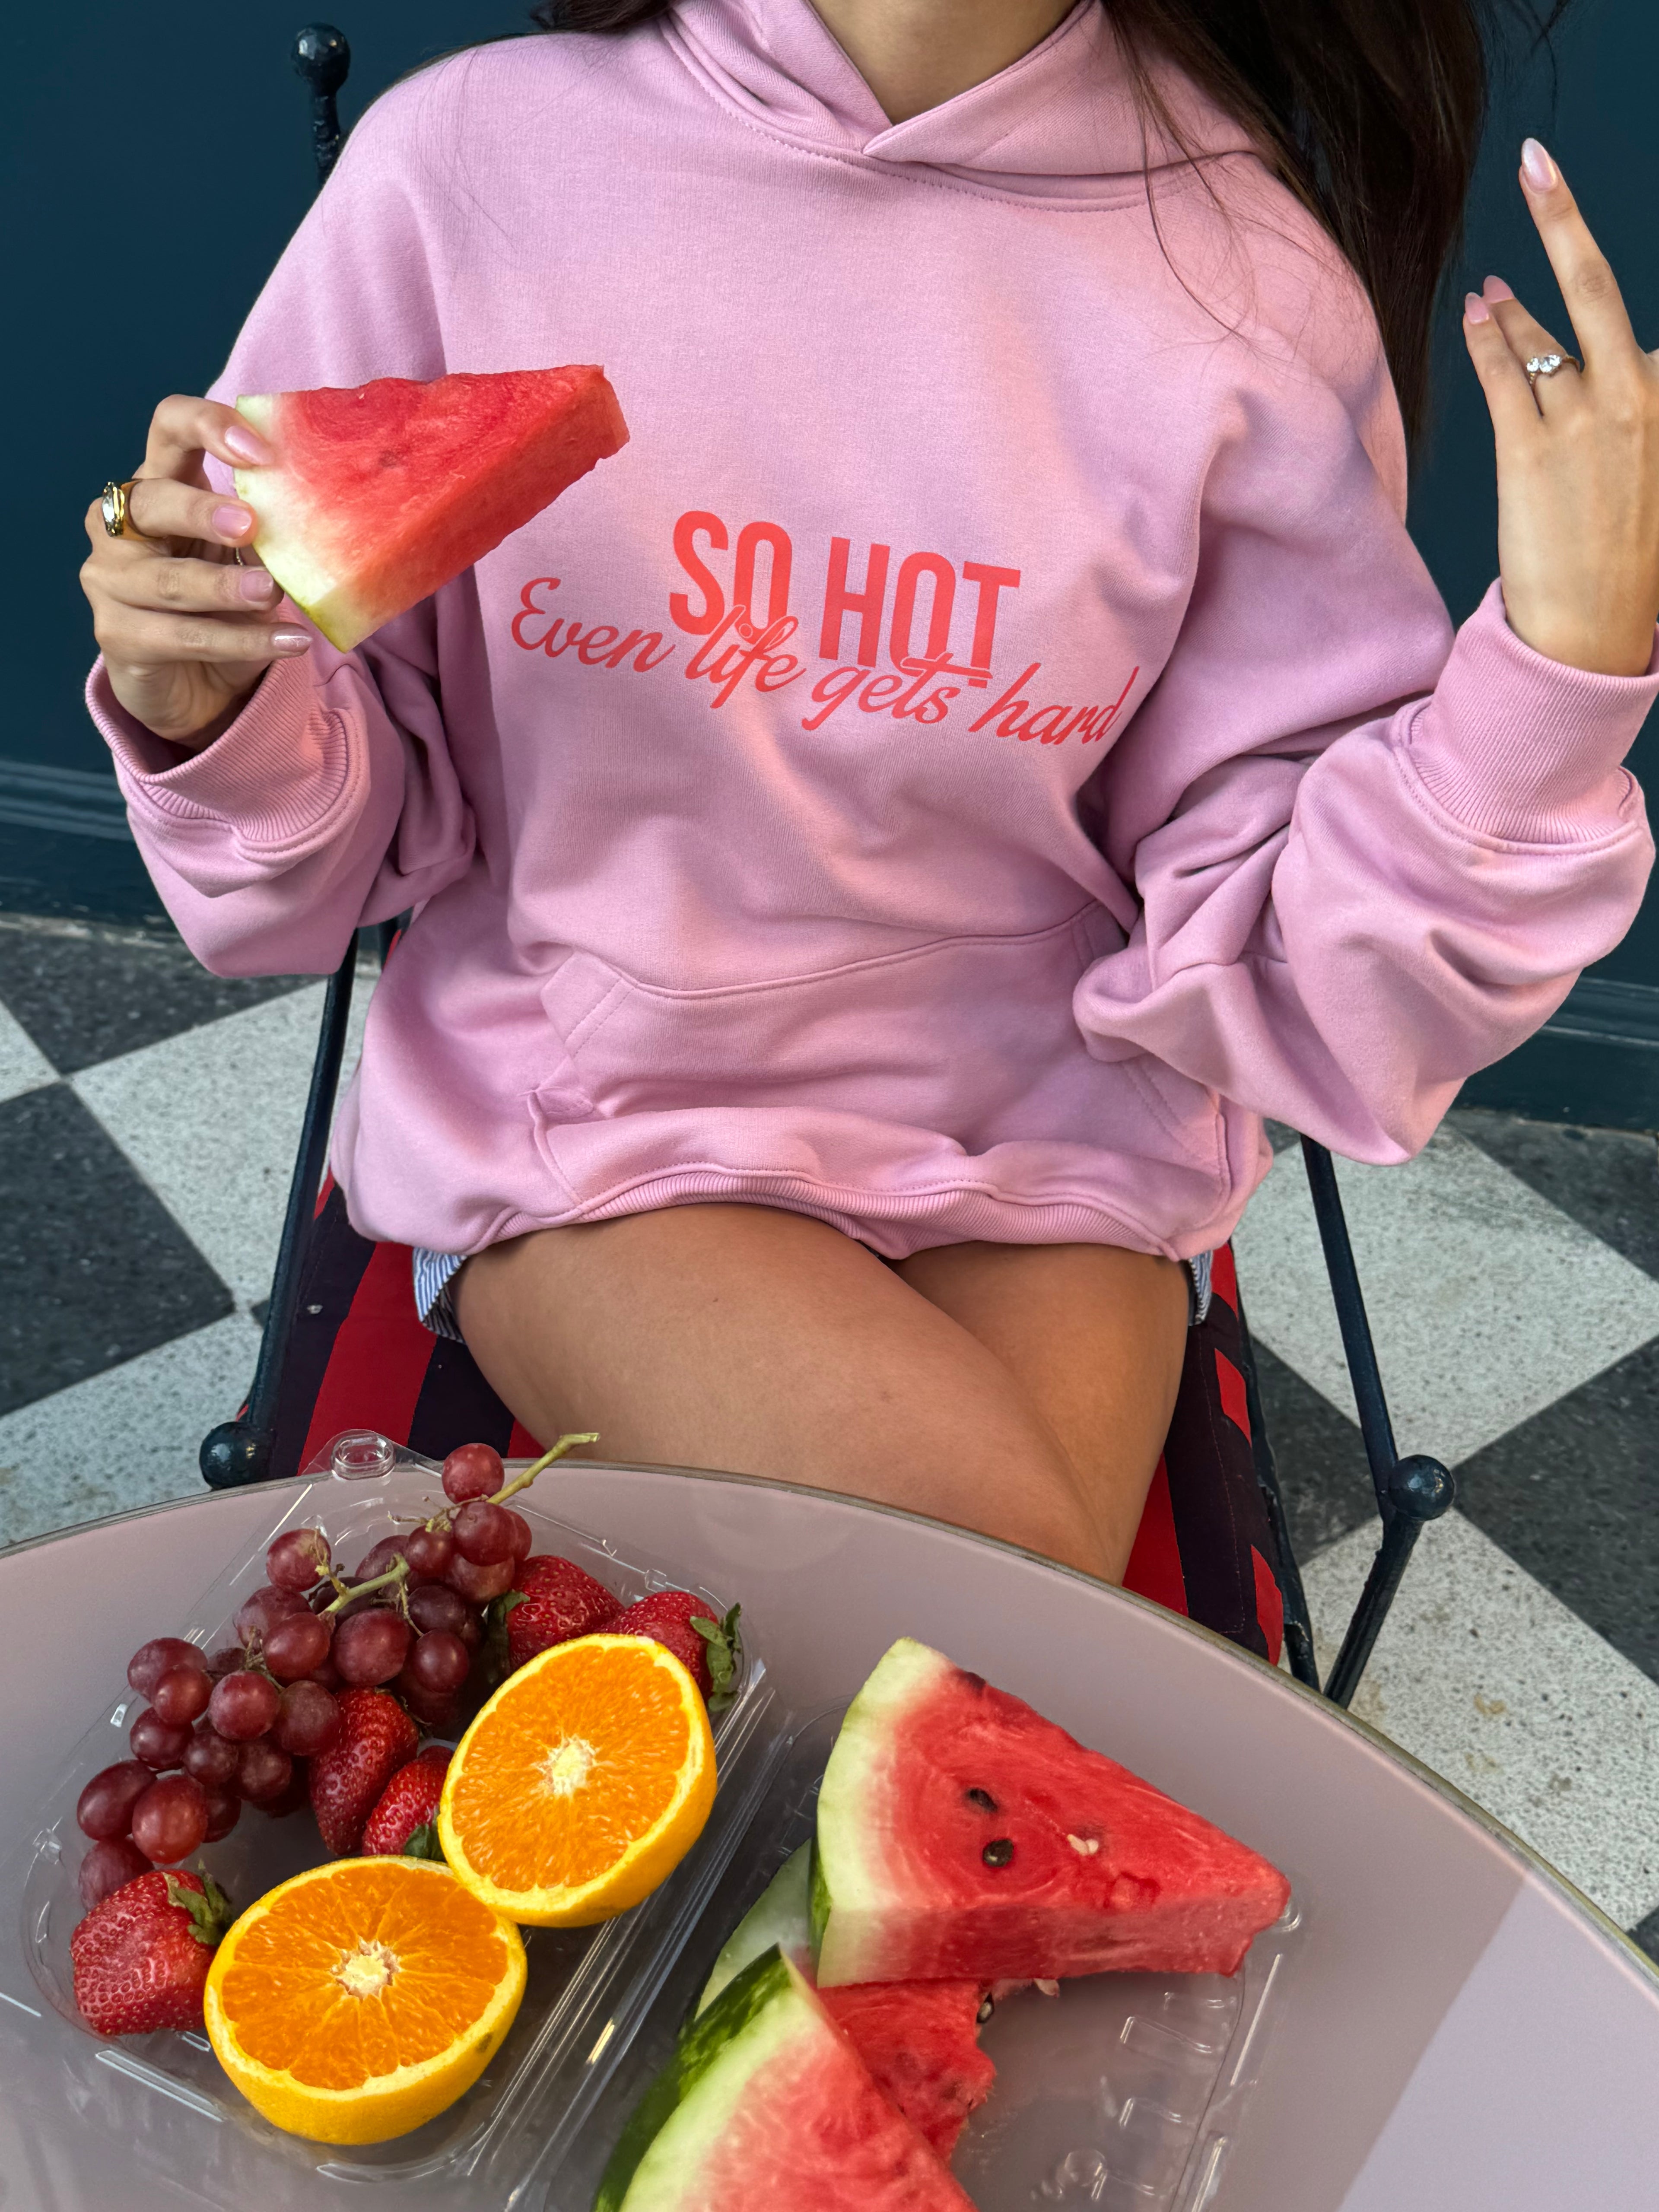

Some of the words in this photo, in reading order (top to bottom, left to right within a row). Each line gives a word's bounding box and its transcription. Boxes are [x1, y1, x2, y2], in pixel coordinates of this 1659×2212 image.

[511, 577, 675, 673] Even
[685, 604, 807, 709] life
[801, 652, 994, 731] gets
[968, 662, 1140, 746] hard
[669, 510, 792, 645] SO
[818, 536, 1021, 689] HOT
